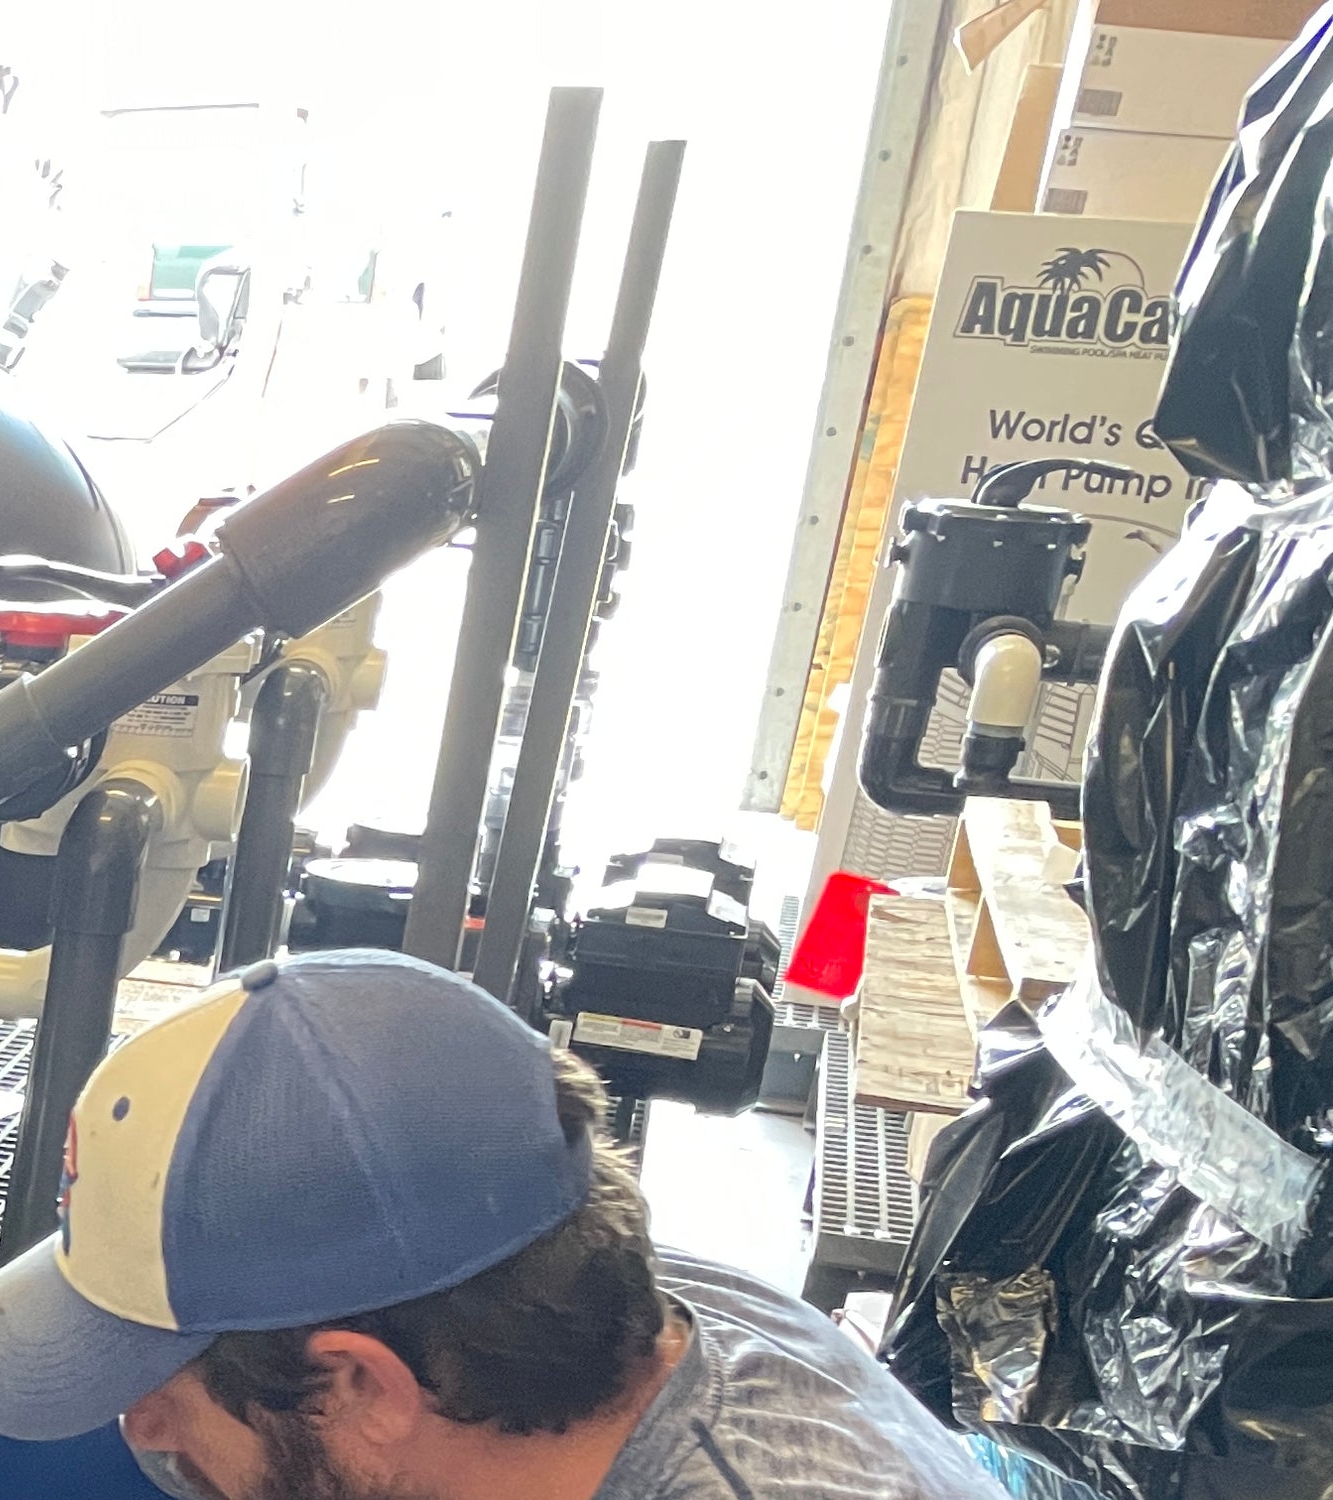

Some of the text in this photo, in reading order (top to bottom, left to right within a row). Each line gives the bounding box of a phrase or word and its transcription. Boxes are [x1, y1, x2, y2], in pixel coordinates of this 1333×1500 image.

[960, 281, 1169, 345] AquaCa
[989, 409, 1122, 447] World's
[1061, 467, 1173, 504] Pump
[151, 695, 186, 705] UTION
